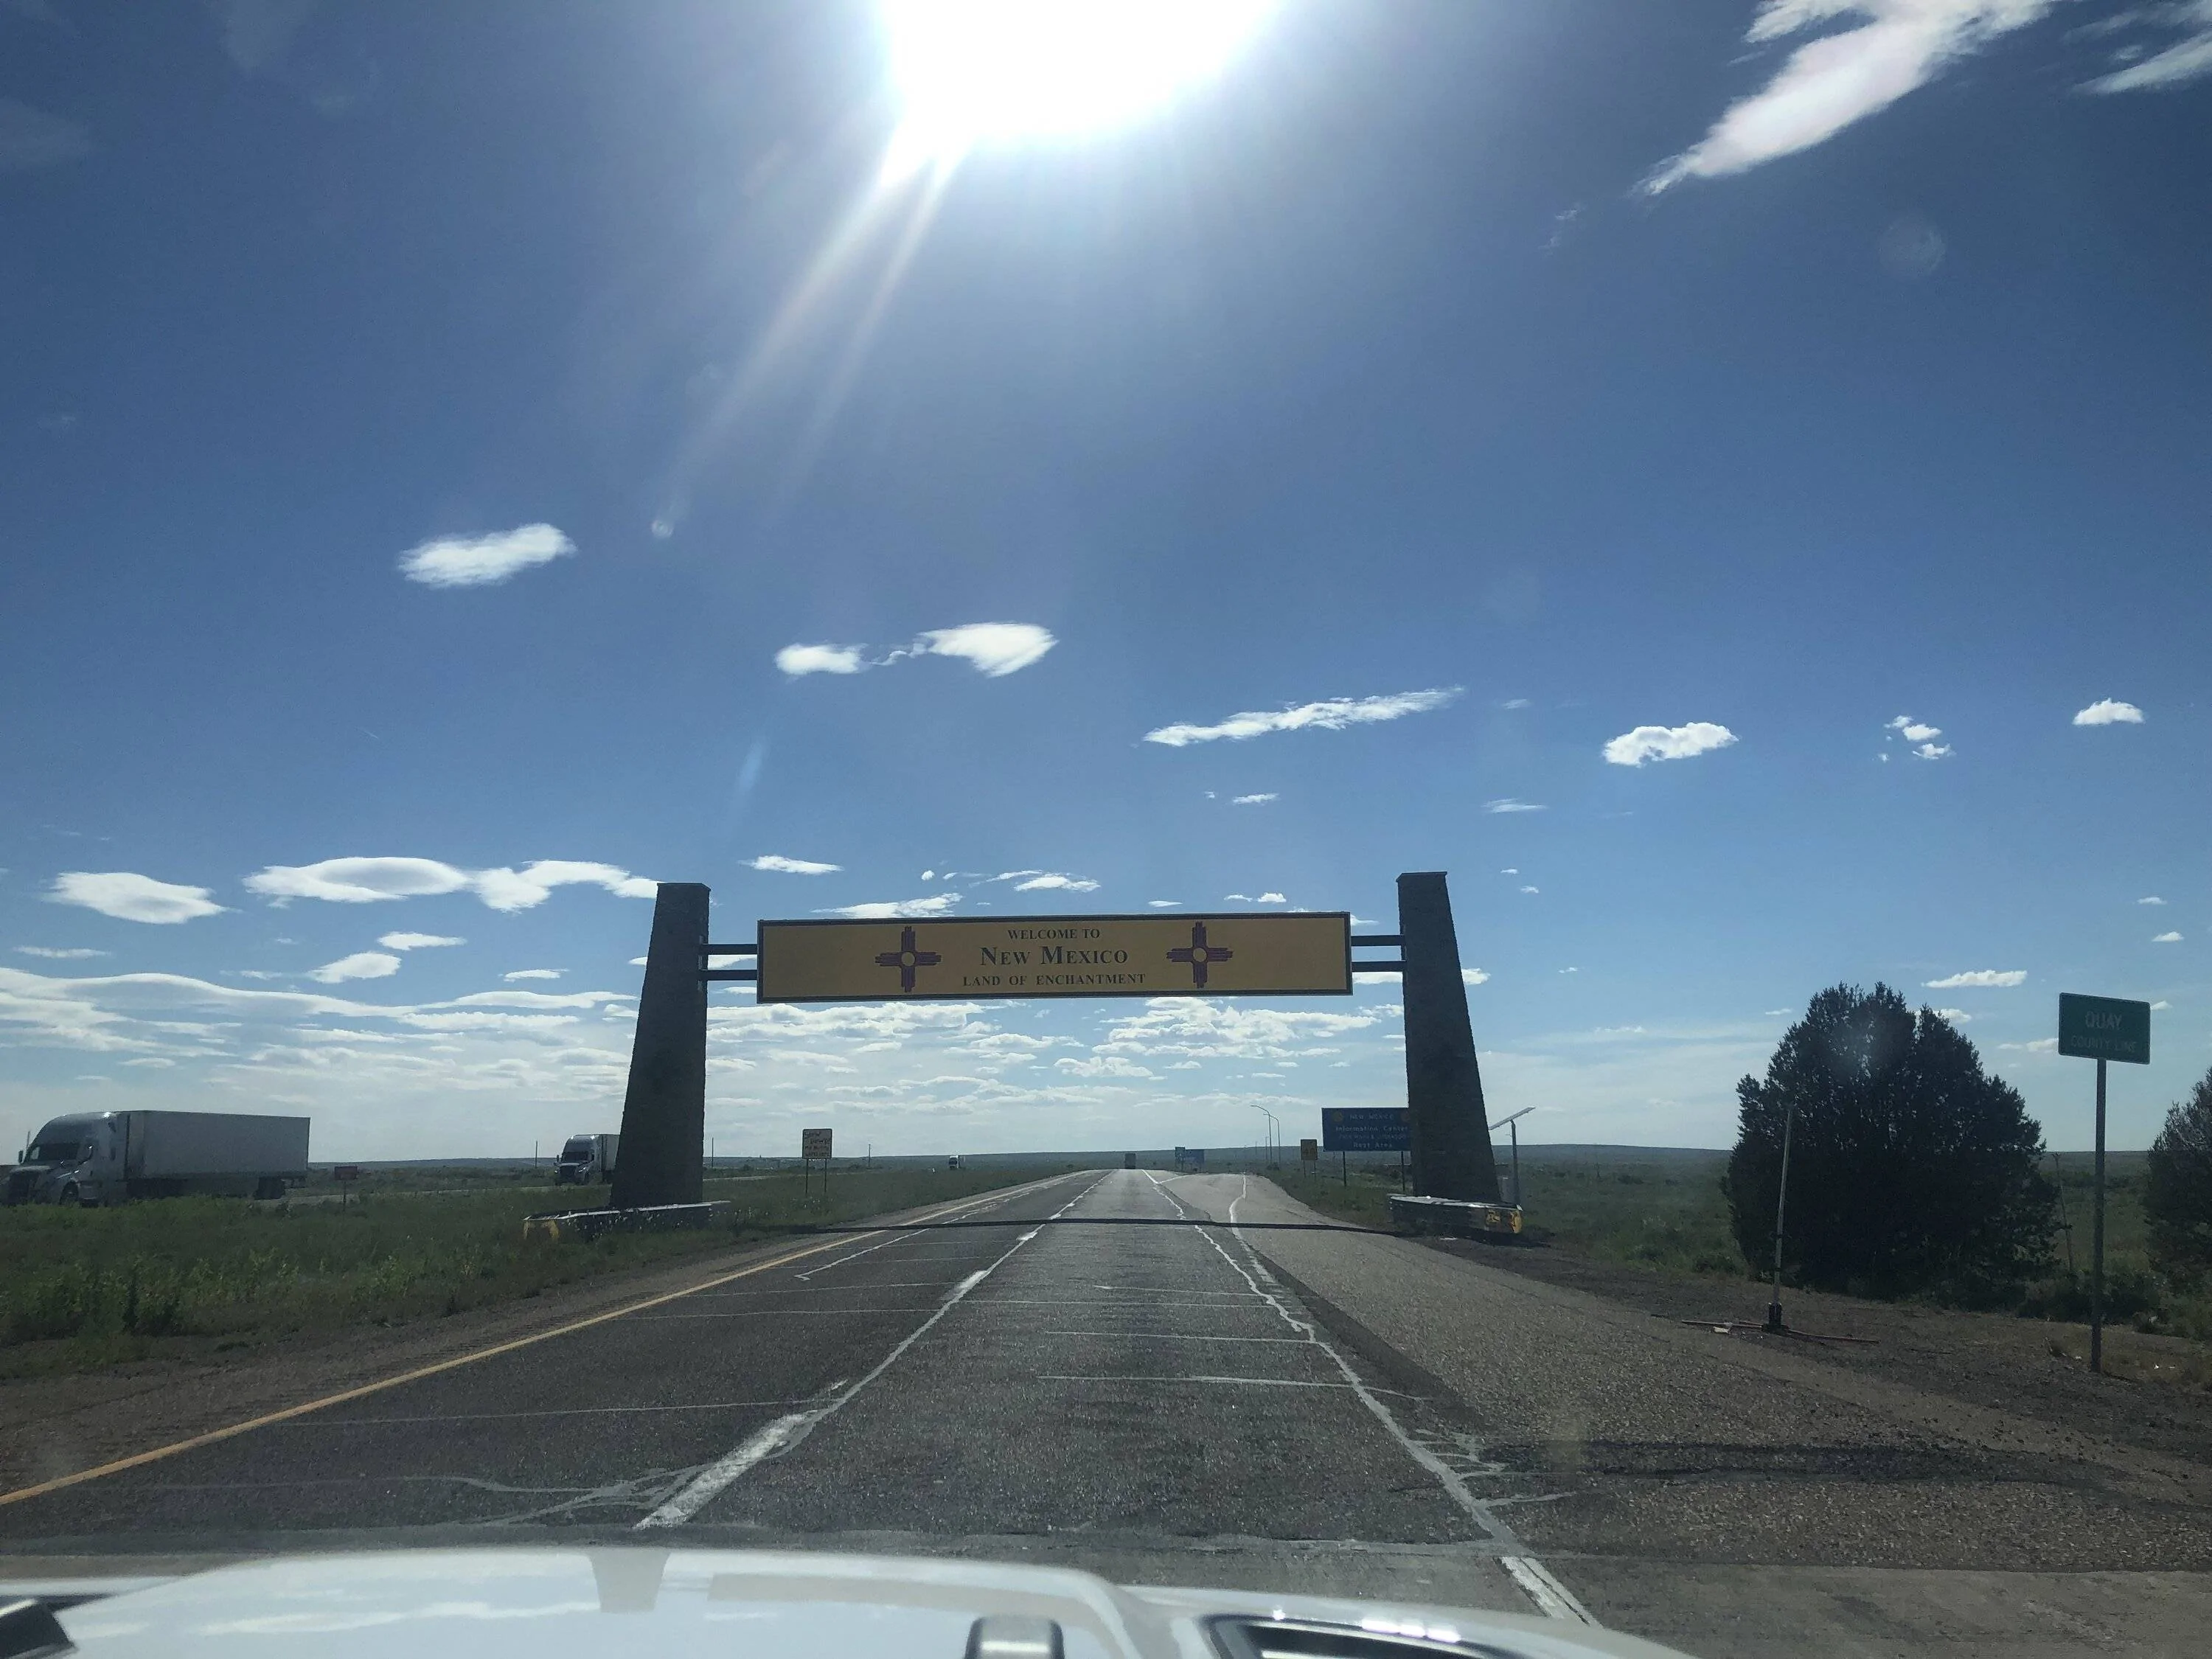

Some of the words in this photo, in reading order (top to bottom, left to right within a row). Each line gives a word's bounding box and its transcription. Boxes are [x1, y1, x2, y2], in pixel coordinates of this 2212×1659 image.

[1007, 929, 1077, 940] WELCOME
[1082, 928, 1100, 939] TO
[980, 947, 1032, 966] NEW
[1040, 945, 1129, 964] MEXICO
[963, 975, 1001, 987] LAND
[1009, 975, 1027, 986] OF
[1036, 973, 1146, 985] ENCHANTMENT
[2084, 1010, 2122, 1030] QUAY
